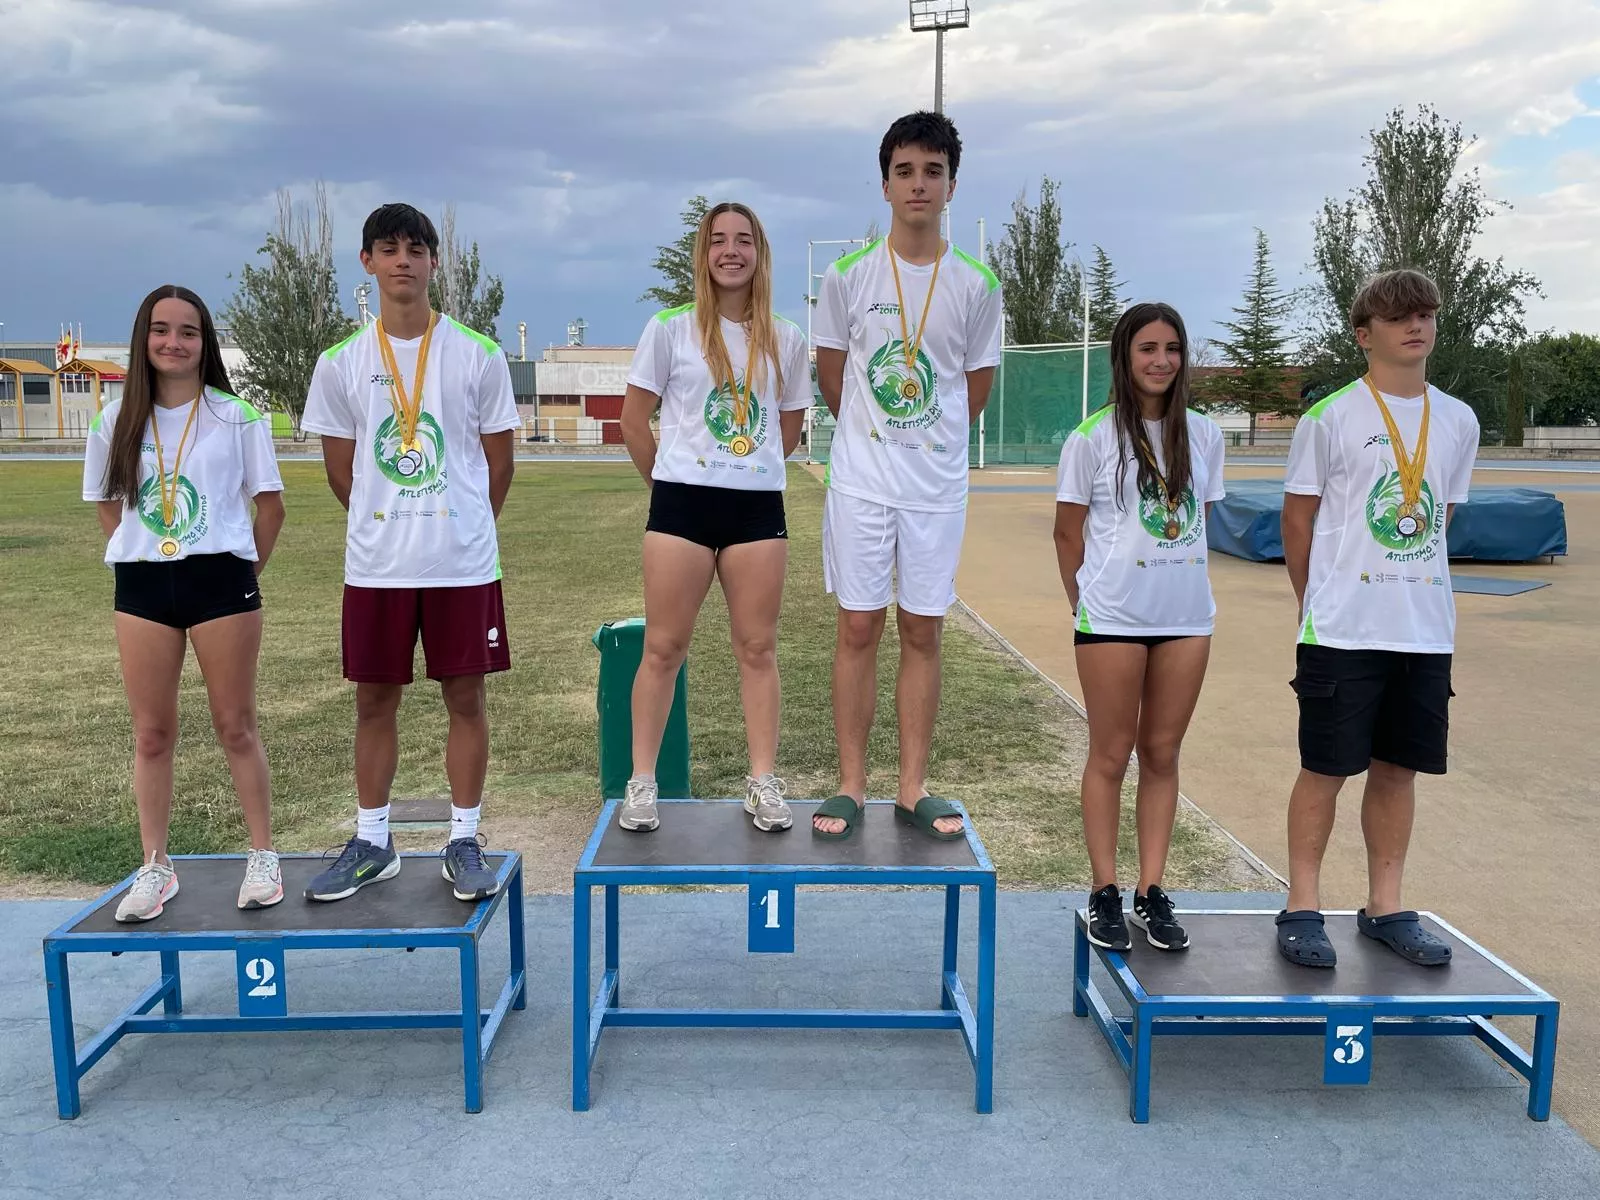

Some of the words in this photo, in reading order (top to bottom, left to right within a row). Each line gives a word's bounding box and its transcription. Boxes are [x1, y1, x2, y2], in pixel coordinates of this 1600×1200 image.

[753, 406, 768, 442] DIVERTIDO
[398, 479, 443, 499] ATLETISMO
[1156, 533, 1194, 549] ATLETISMO
[1384, 545, 1432, 562] ATLETISMO
[760, 889, 781, 929] 1
[245, 958, 277, 998] 2
[1333, 1025, 1364, 1064] 3
